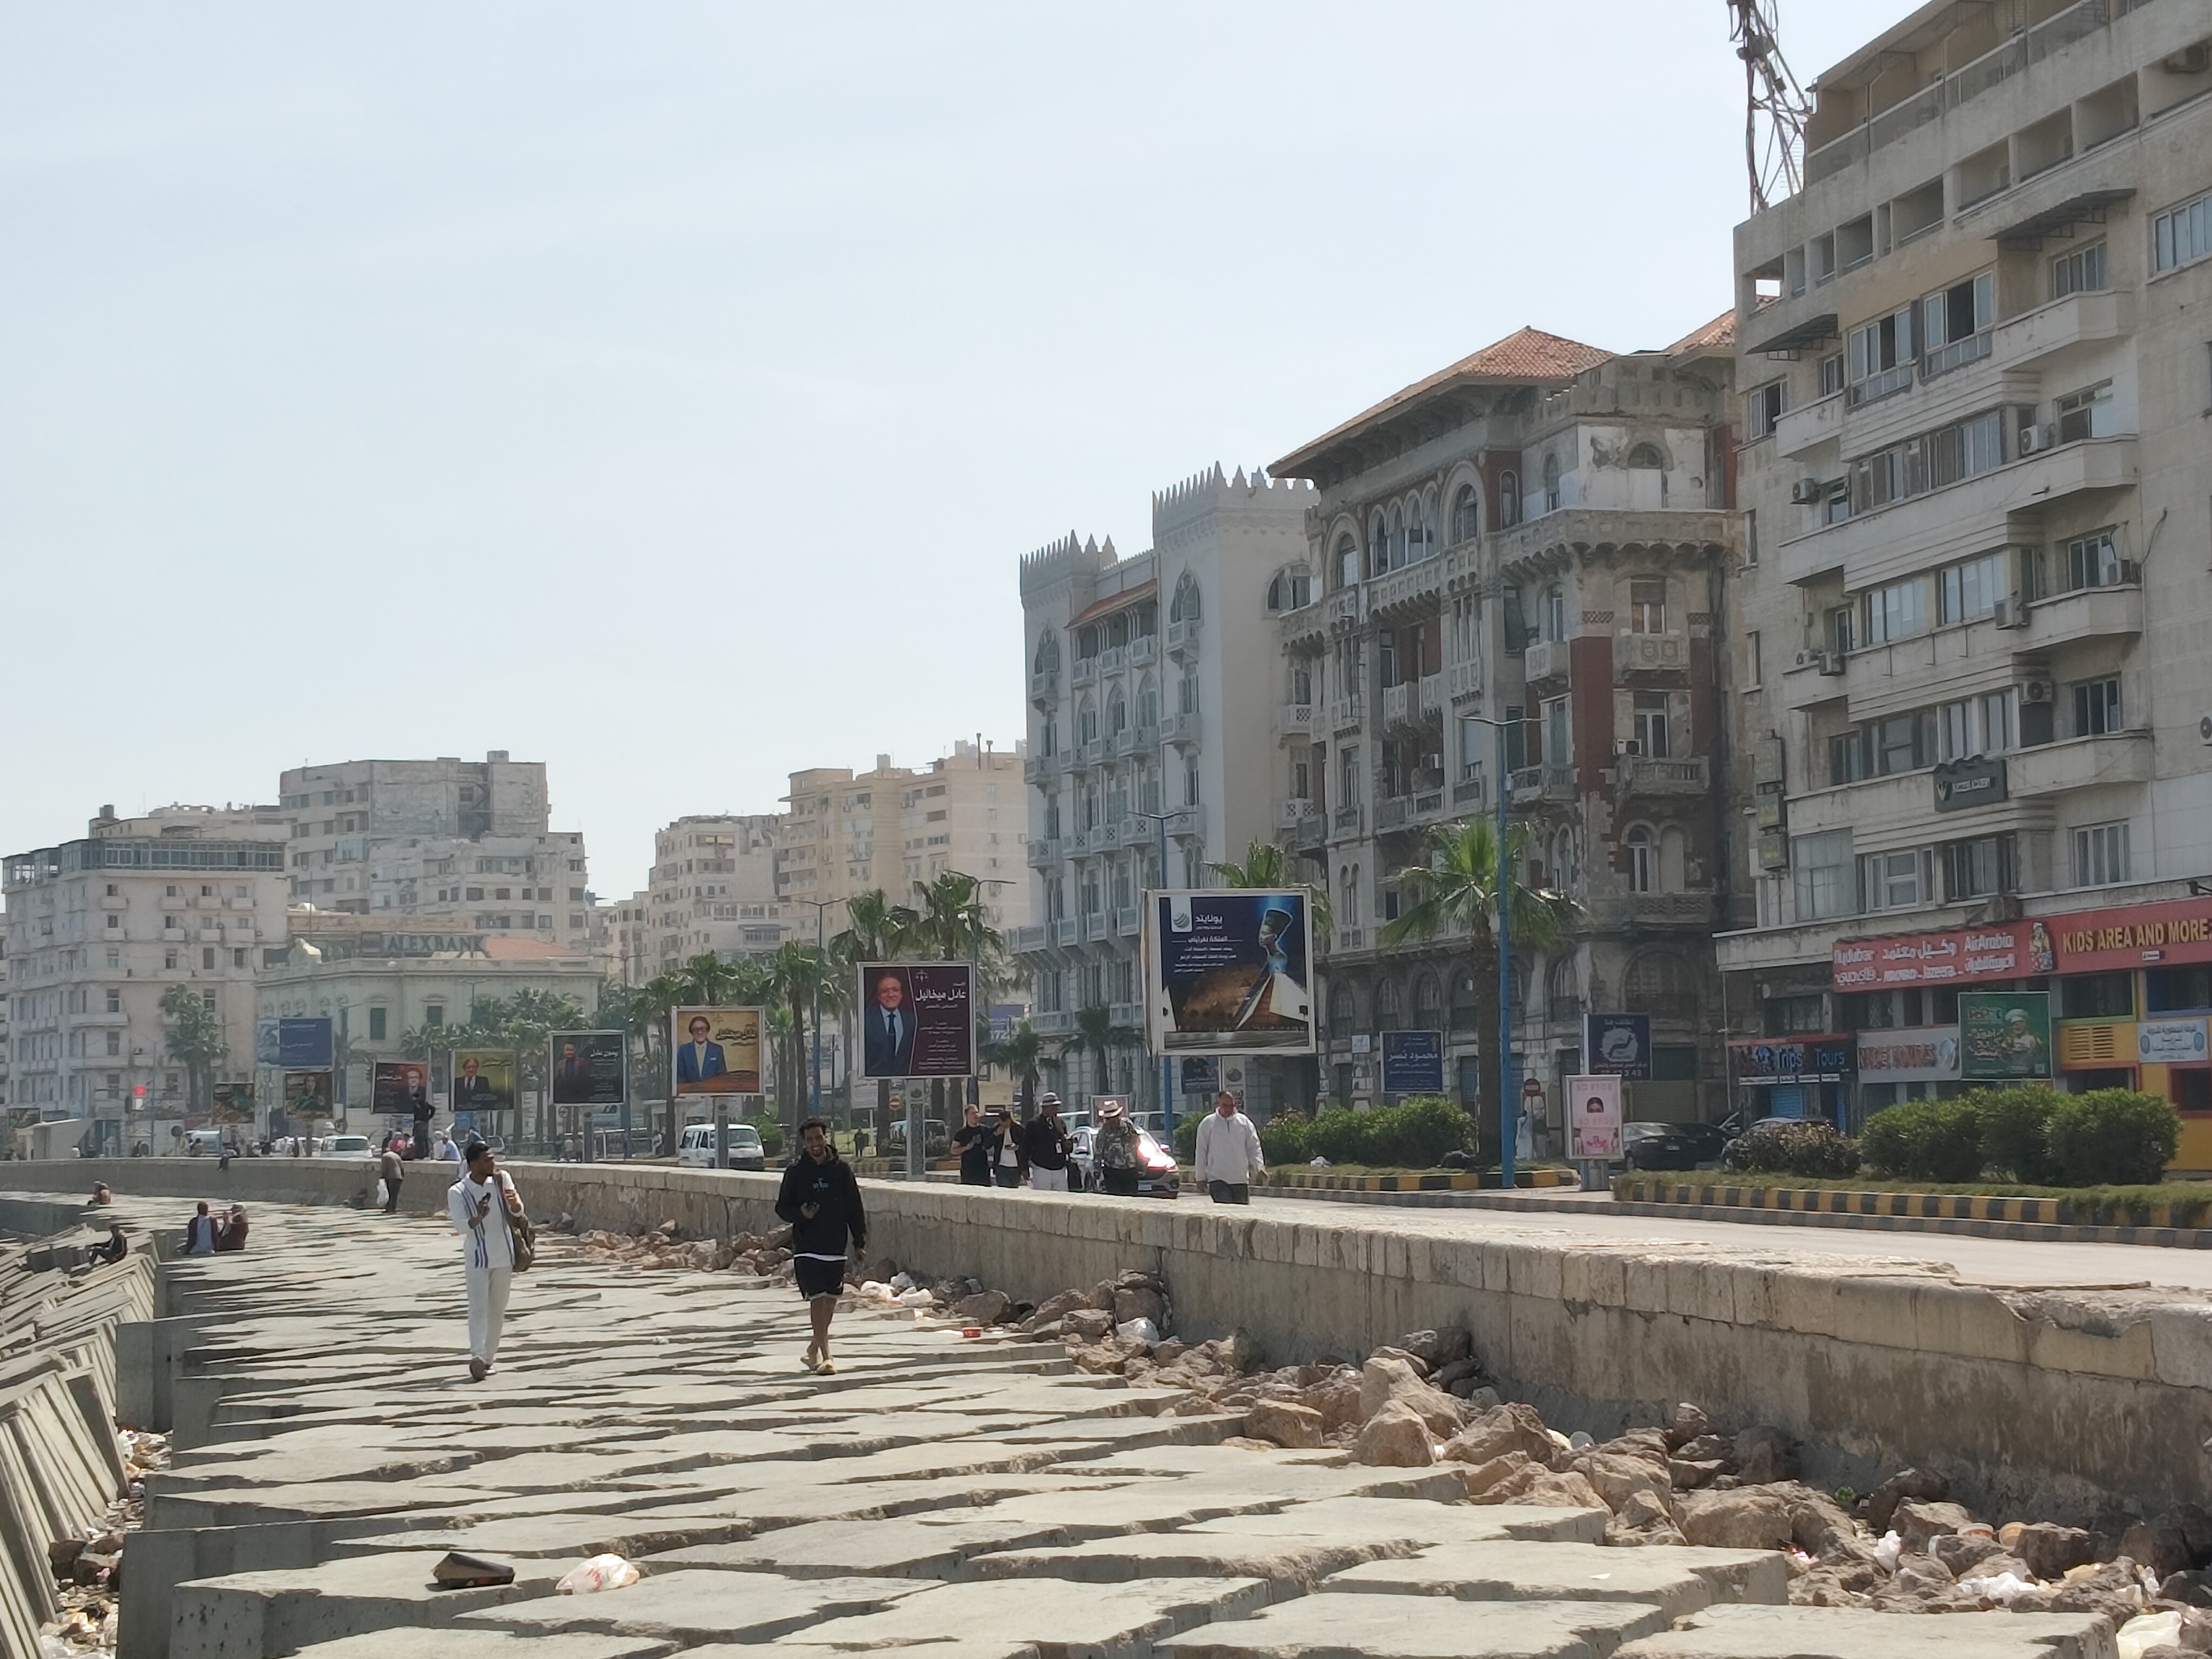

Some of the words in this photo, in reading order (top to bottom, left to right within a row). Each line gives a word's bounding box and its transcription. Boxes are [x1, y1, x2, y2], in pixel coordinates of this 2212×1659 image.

[2063, 930, 2094, 954] KIDS
[2097, 926, 2134, 950] AREA
[2136, 923, 2164, 946] AND
[1882, 943, 1917, 960] معتمد
[1917, 939, 1957, 960] وكيل
[915, 989, 947, 1001] ميخائيل
[948, 988, 966, 1001] عادل
[1388, 1050, 1407, 1062] نصر
[1408, 1052, 1438, 1061] محمود
[1815, 1048, 1845, 1067] Tours
